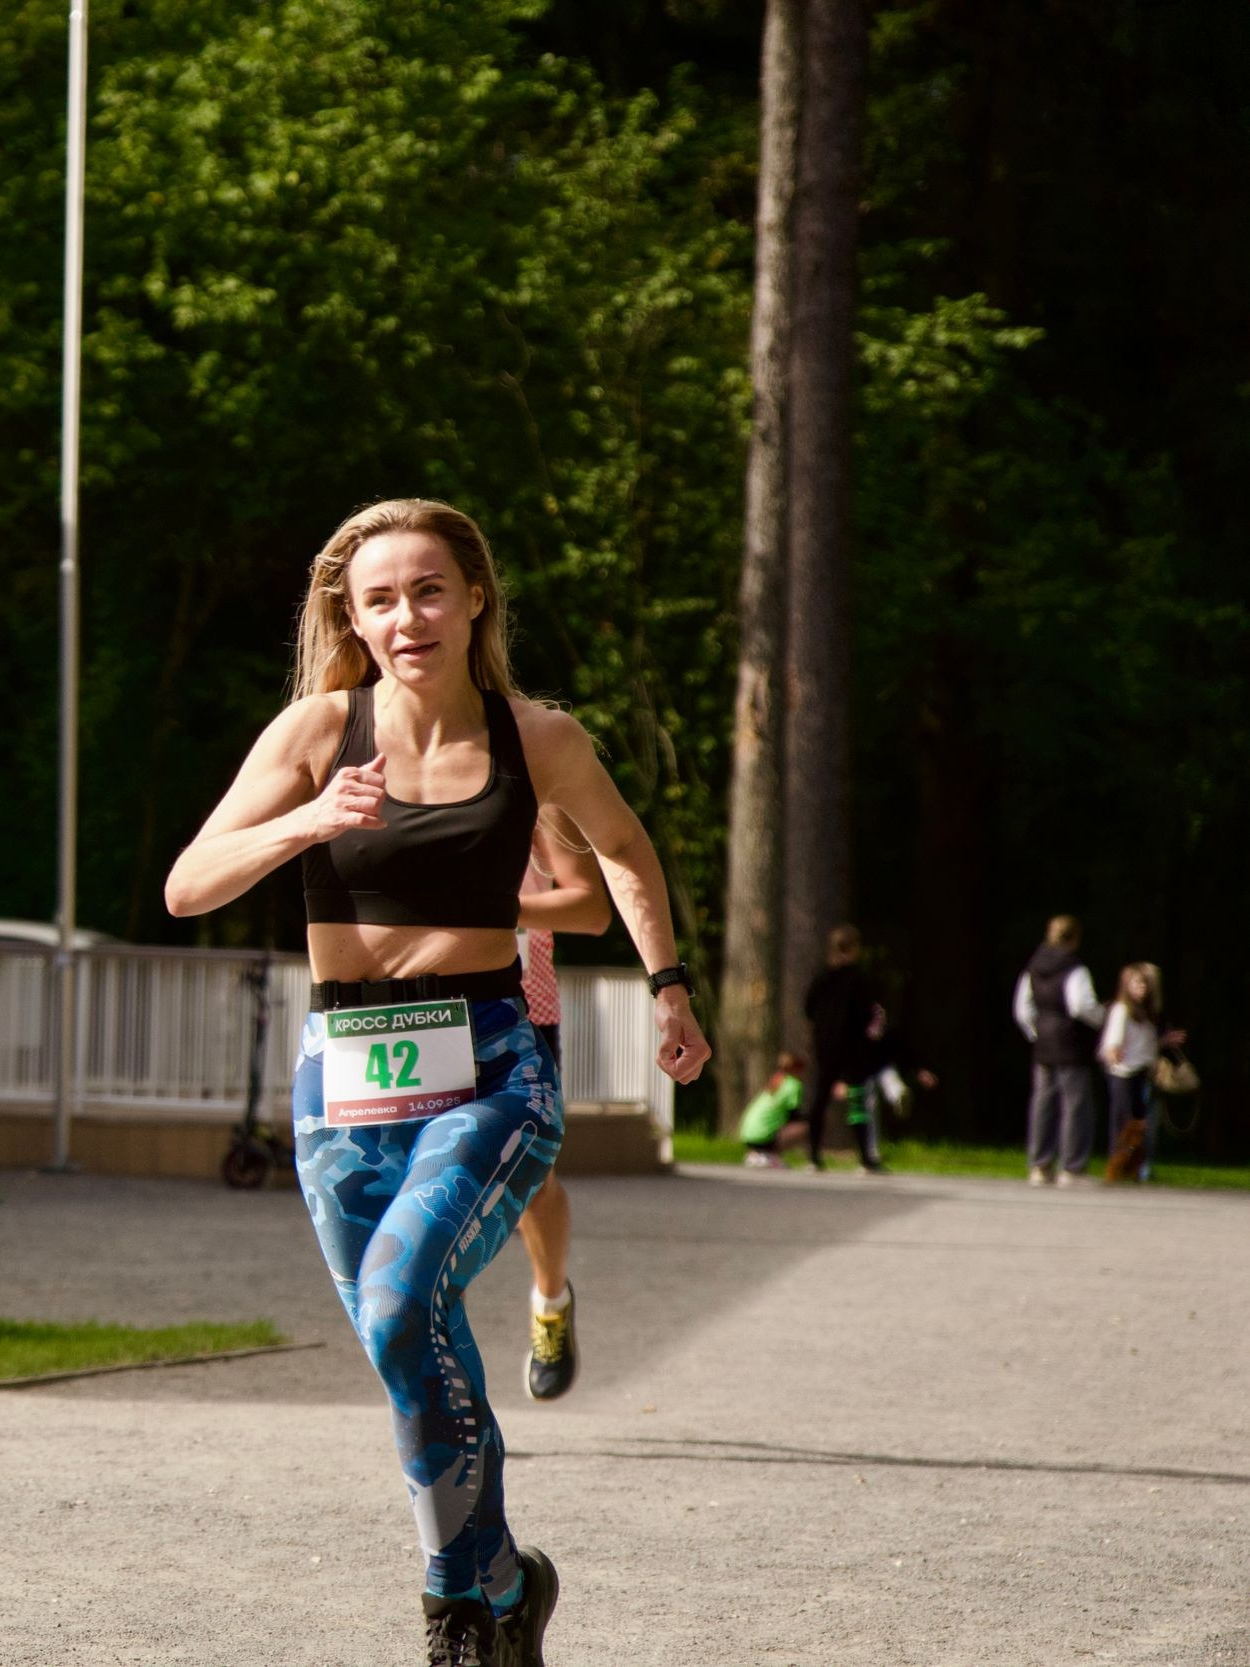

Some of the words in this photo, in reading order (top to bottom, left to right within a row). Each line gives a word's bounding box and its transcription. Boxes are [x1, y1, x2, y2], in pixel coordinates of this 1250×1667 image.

[335, 1015, 388, 1033] КРОСС
[391, 1009, 452, 1029] ДУБКИ
[365, 1040, 422, 1090] 42
[338, 1105, 398, 1118] Апрелевка
[408, 1096, 461, 1112] 14.09.25
